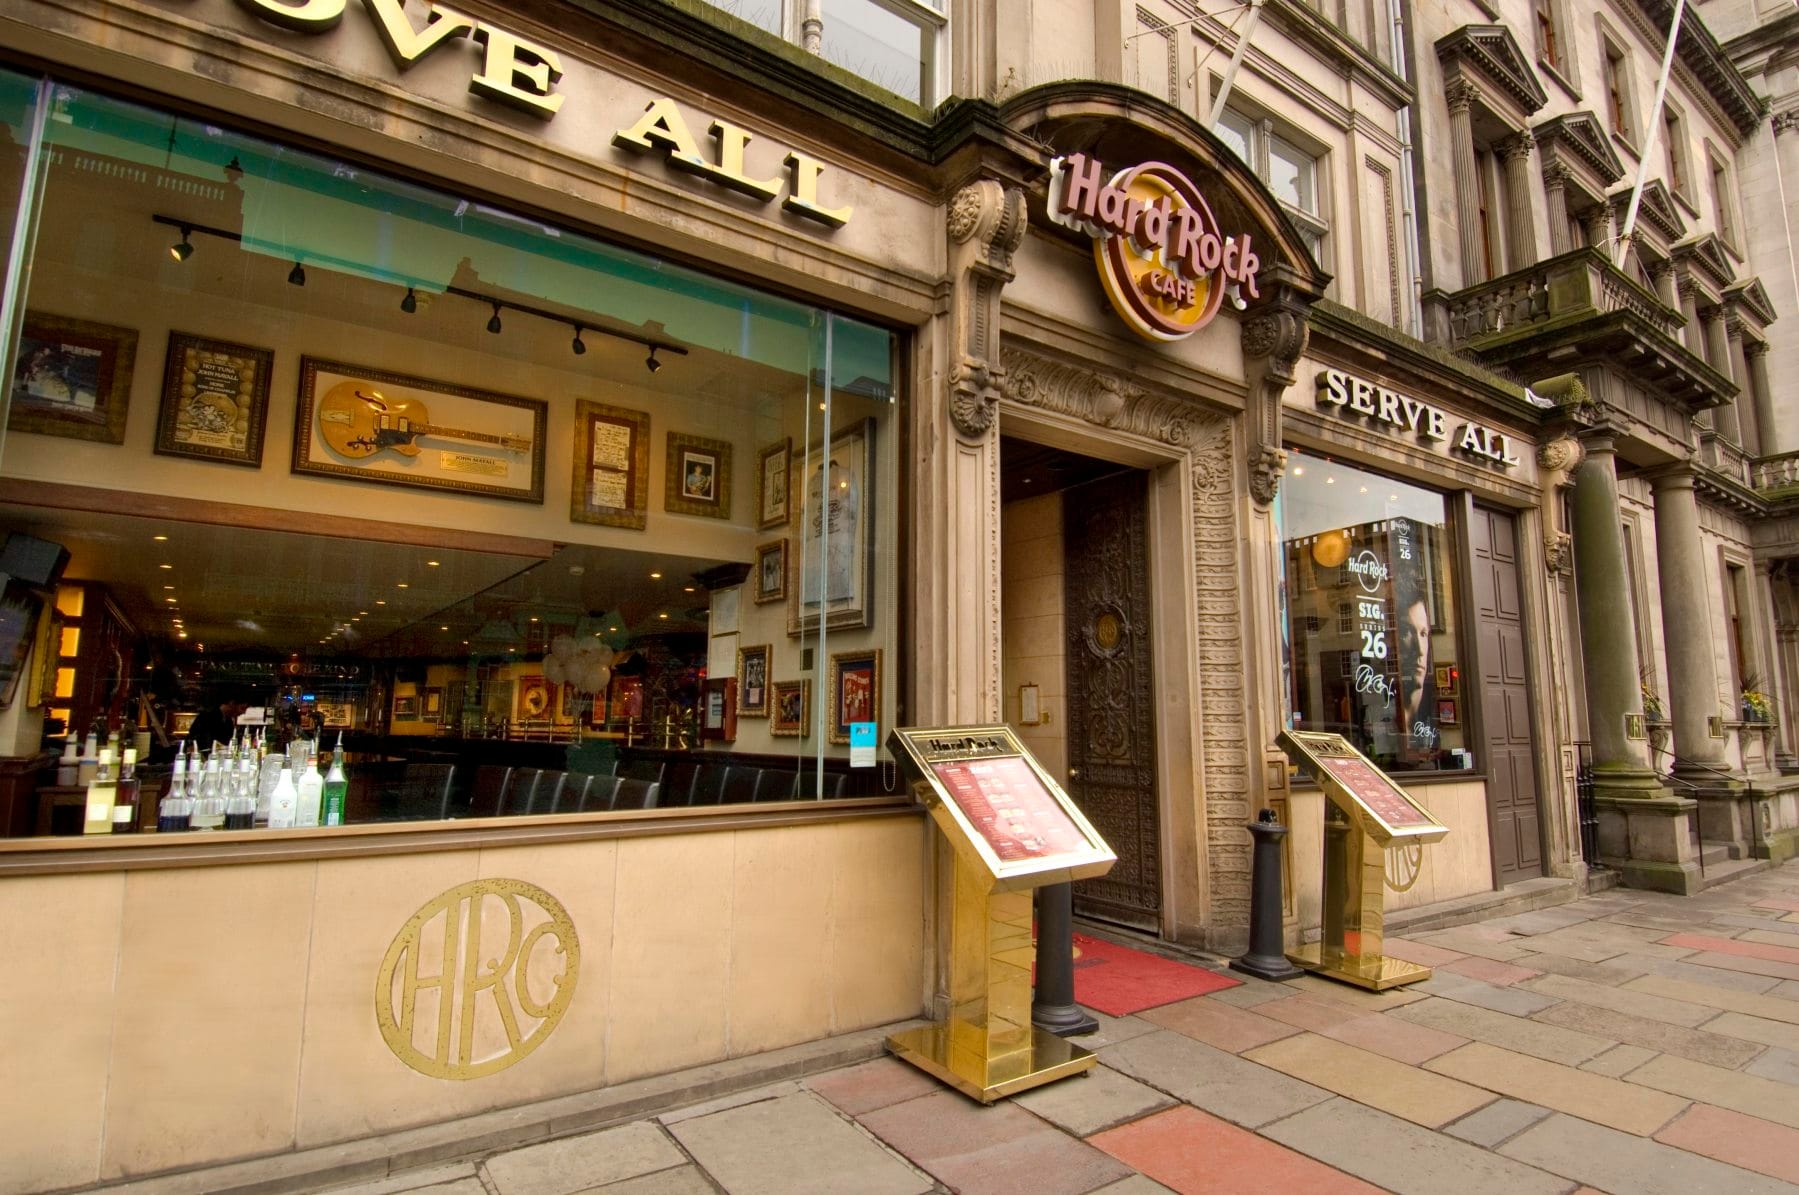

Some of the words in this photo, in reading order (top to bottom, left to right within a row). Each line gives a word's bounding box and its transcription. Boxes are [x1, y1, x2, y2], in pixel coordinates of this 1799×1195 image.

[237, 0, 566, 121] VE
[611, 97, 853, 229] ALL
[1059, 152, 1171, 249] Hard
[1170, 207, 1261, 299] Rock
[1146, 270, 1197, 307] CAFE
[1319, 368, 1448, 441] SERVE
[1456, 422, 1520, 467] ALL
[1400, 548, 1411, 560] 26
[1348, 557, 1368, 574] Hard
[1368, 561, 1388, 580] Rock
[1358, 602, 1385, 620] SIG.
[1361, 631, 1387, 659] 26
[929, 738, 965, 751] Hard
